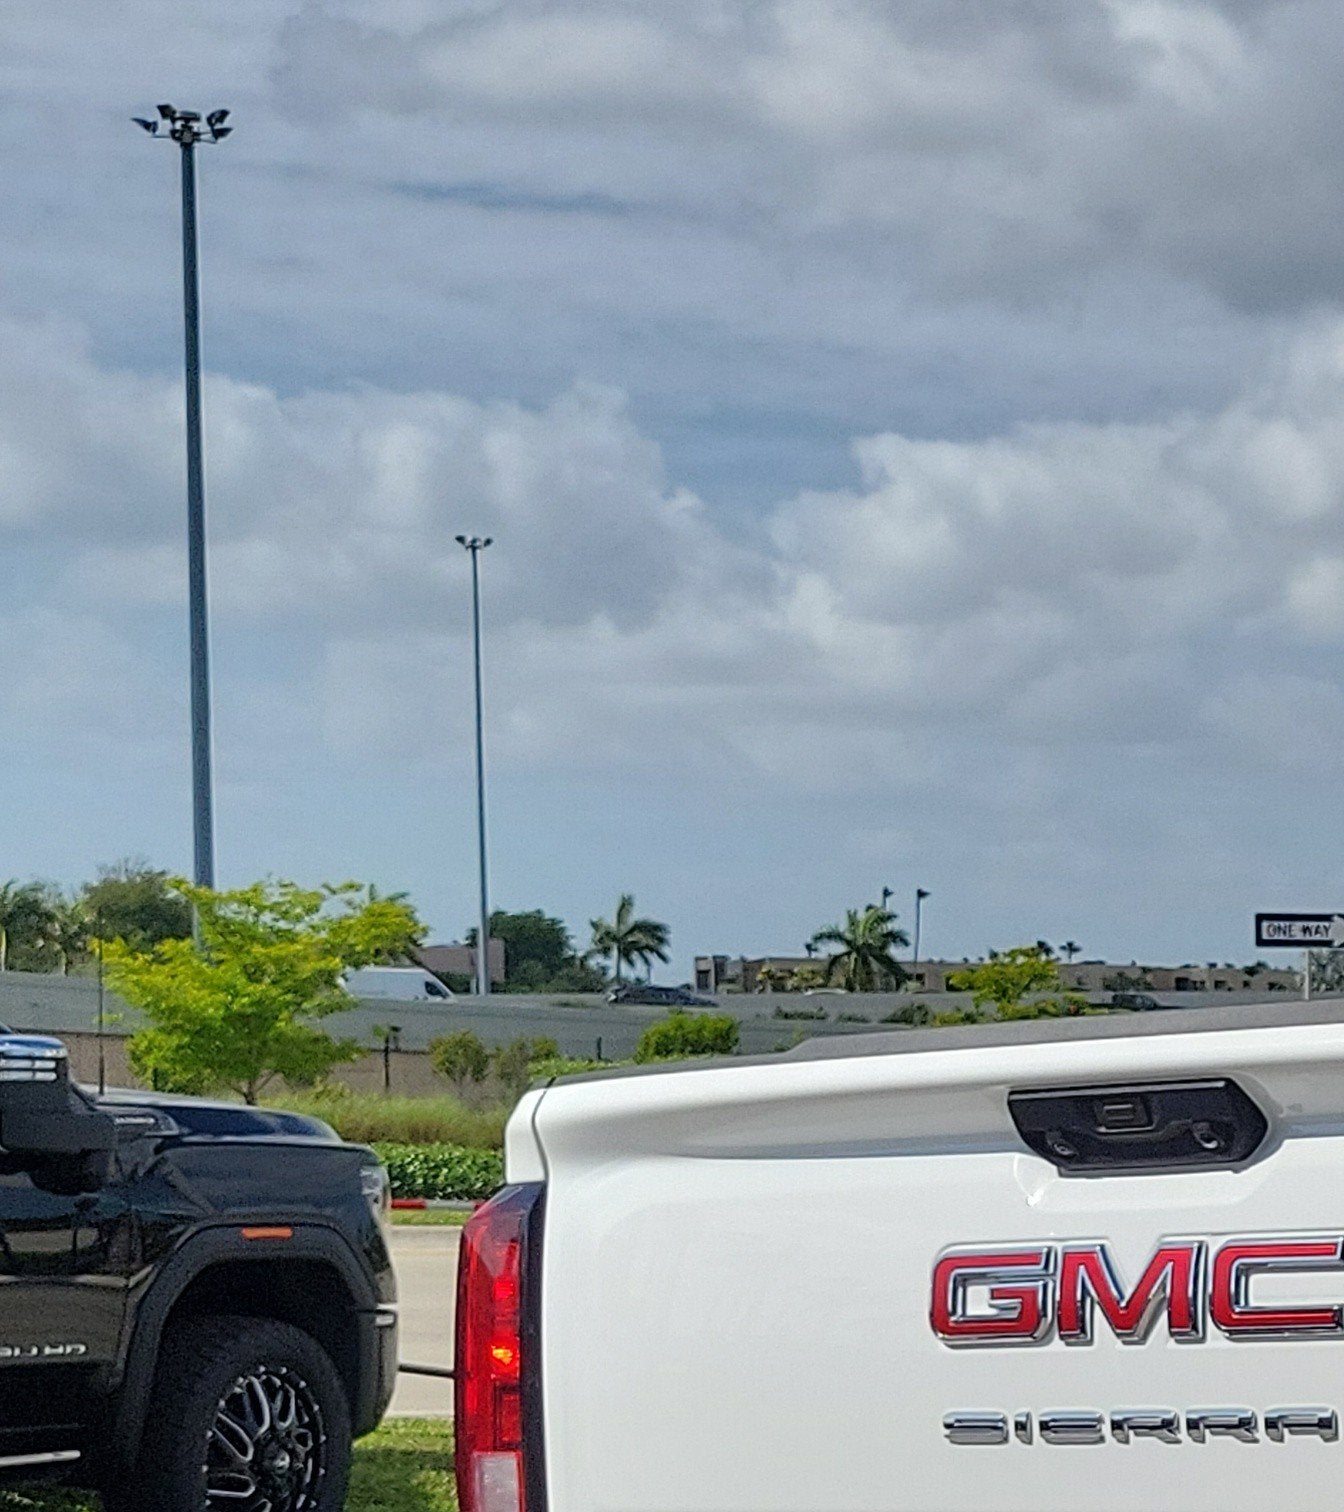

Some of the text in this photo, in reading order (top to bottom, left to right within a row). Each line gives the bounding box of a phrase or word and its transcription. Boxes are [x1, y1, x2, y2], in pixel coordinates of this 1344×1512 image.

[1265, 923, 1331, 938] ONE WAY
[942, 1407, 1340, 1445] SIERRA
